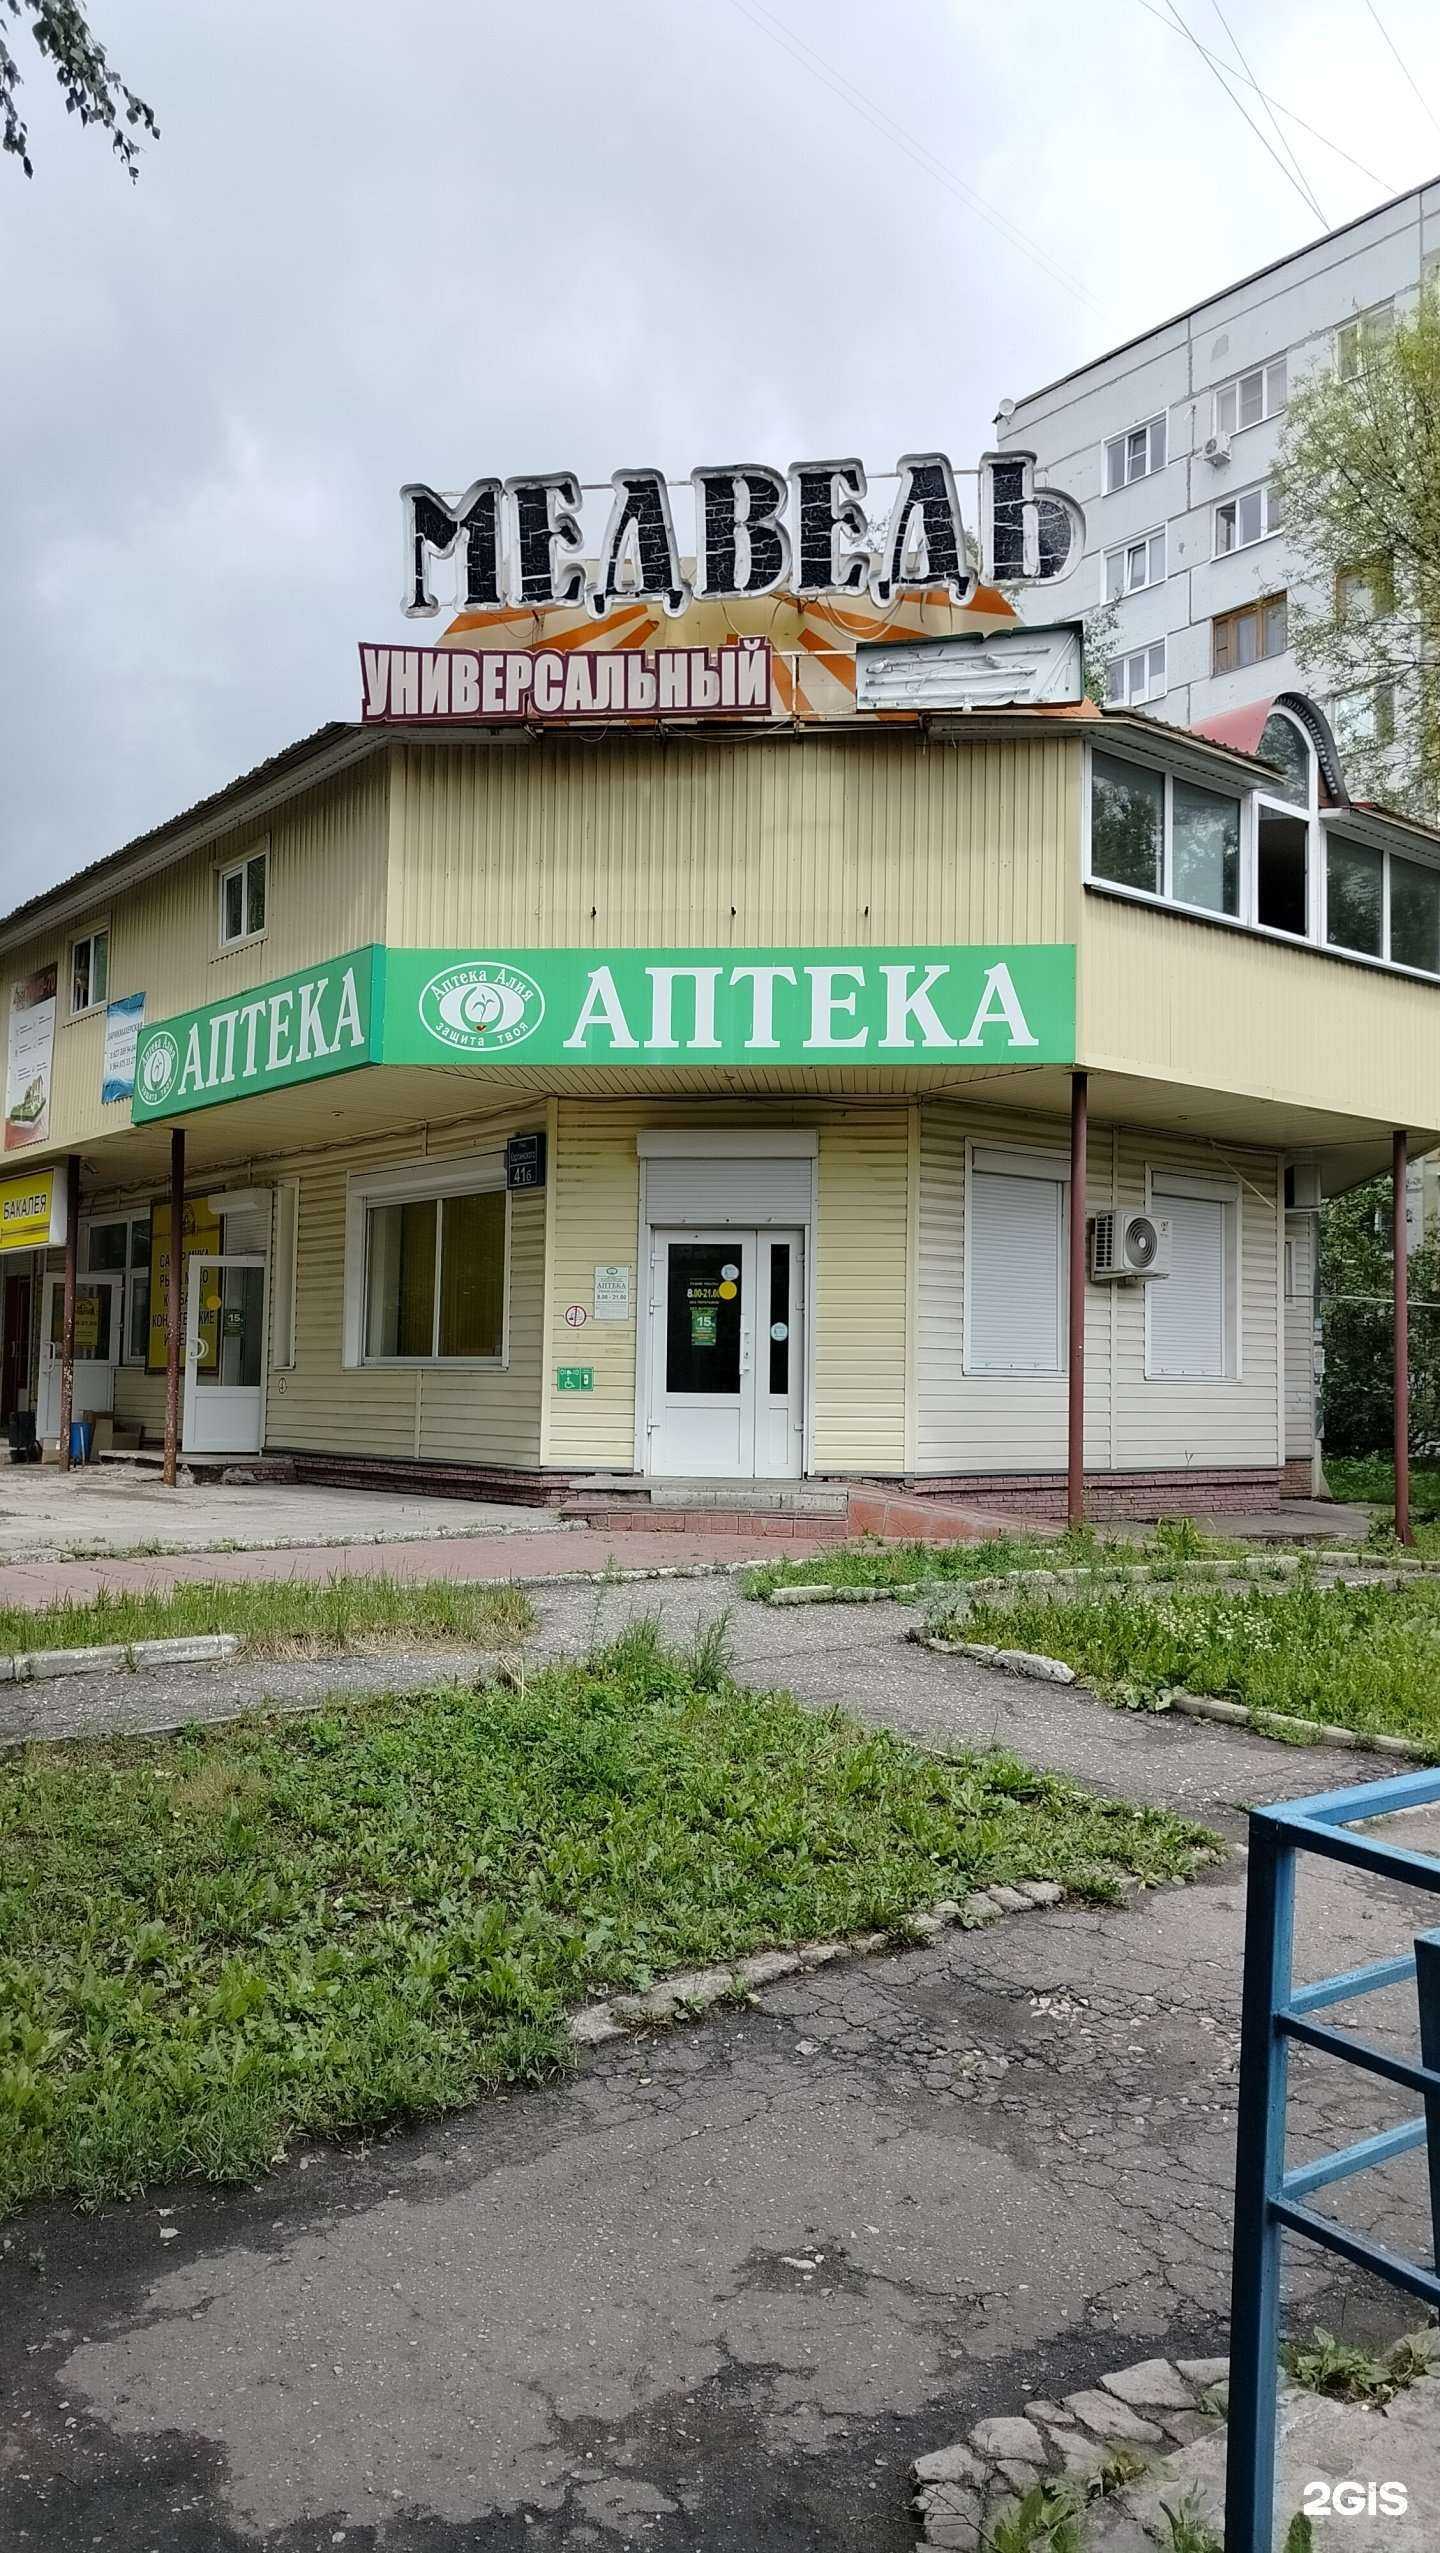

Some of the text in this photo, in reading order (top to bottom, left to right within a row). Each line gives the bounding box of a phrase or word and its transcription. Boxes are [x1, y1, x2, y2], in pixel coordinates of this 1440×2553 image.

[399, 450, 1087, 620] МЕДВЕДЬ
[365, 638, 769, 715] УНИВЕРСАЛЬНЫЙ
[430, 968, 534, 1002] Аптека Алия
[562, 962, 1040, 1050] АПТЕКА
[178, 967, 366, 1095] АПТЕКА
[435, 1021, 529, 1047] защита твоя
[3, 1193, 47, 1221] БАКАЛЕЯ
[159, 1252, 186, 1269] САР
